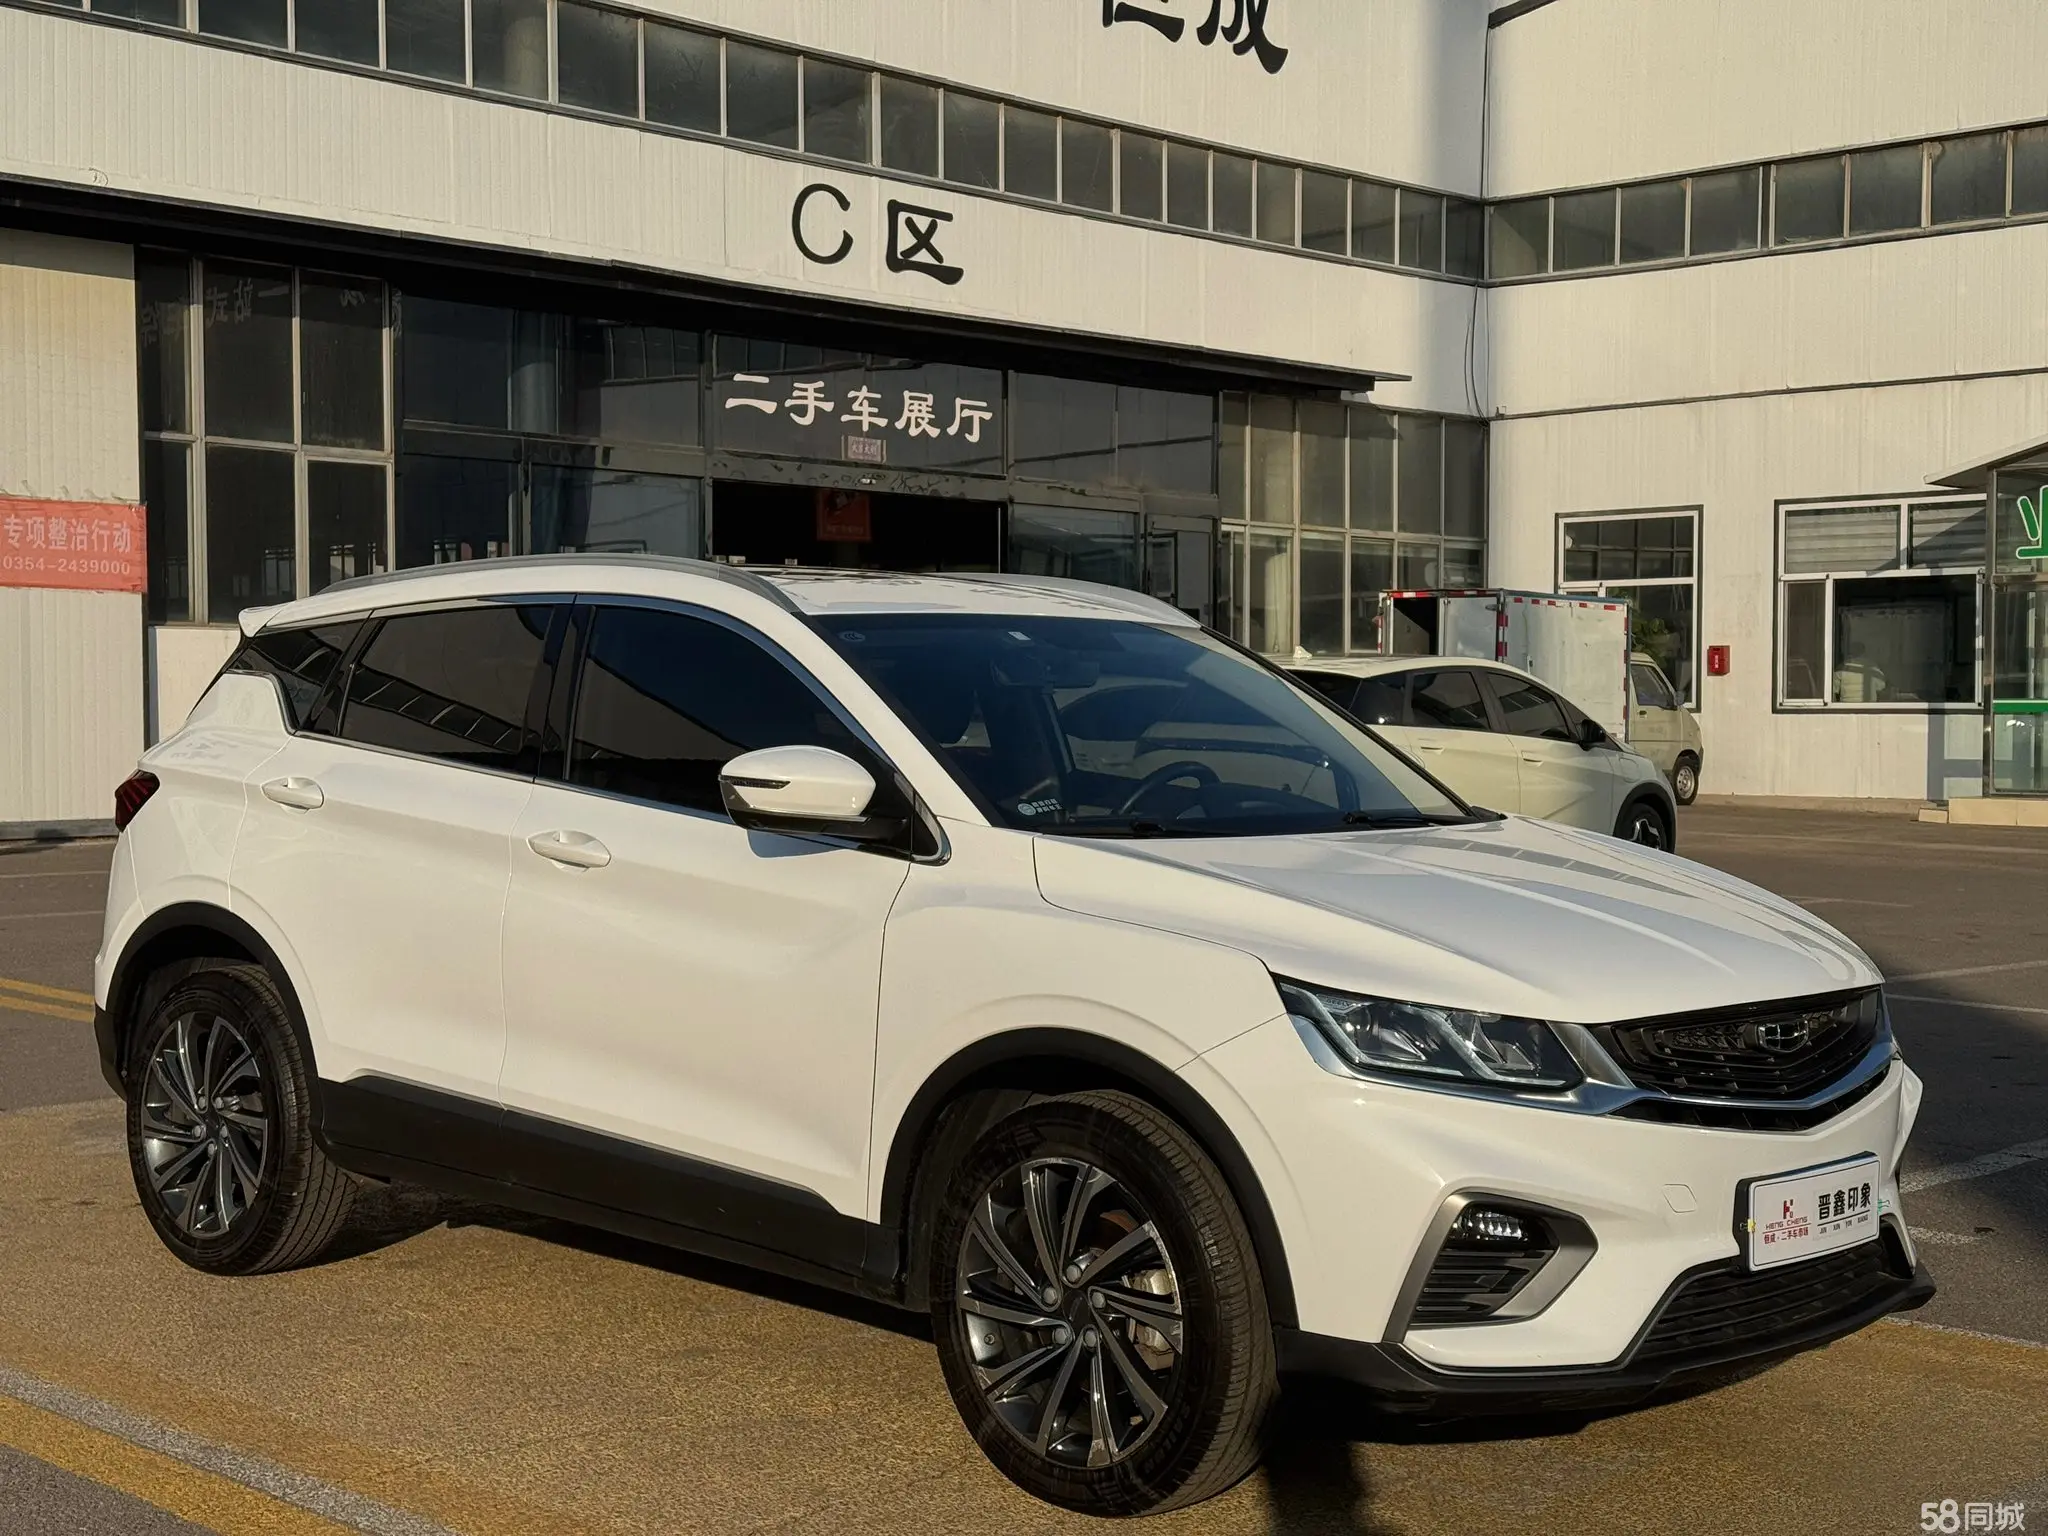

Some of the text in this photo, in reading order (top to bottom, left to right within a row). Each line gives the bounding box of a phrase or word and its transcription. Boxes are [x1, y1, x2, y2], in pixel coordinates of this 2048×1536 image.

[725, 373, 993, 443] 二手车展厅
[4, 514, 132, 553] 专项整治行动
[3, 555, 130, 575] 0354-2439000
[1818, 1182, 1871, 1221] 晋鑫印象
